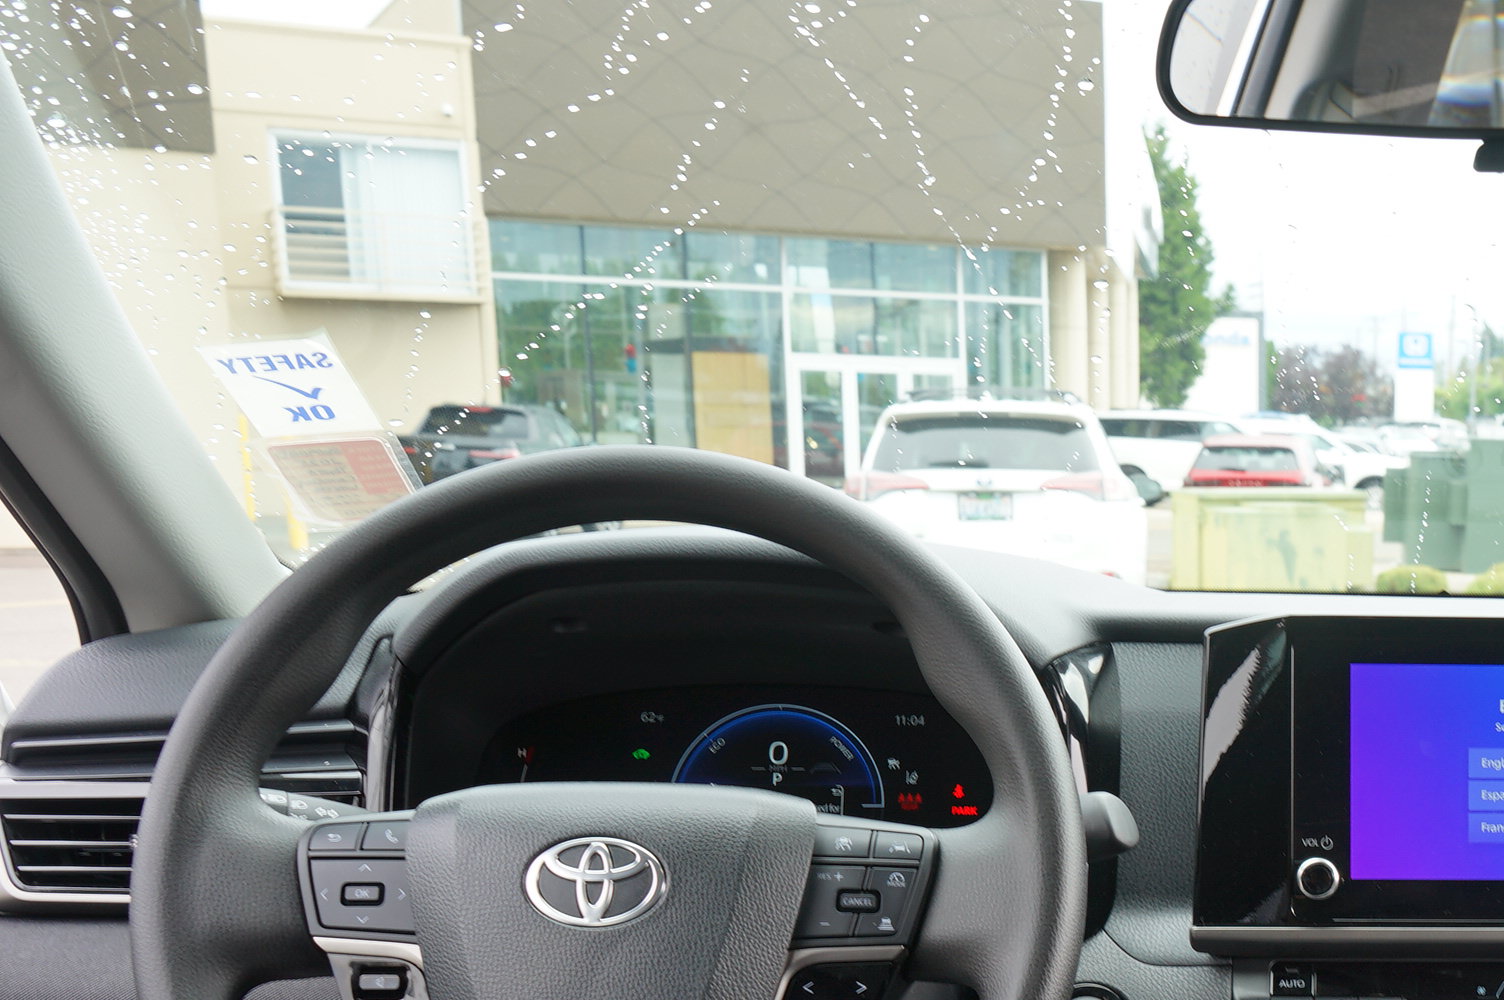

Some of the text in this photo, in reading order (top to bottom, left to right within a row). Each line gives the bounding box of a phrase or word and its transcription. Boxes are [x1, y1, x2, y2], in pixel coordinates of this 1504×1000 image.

[895, 714, 926, 727] 11:04
[708, 737, 726, 754] ECO
[829, 735, 855, 761] POWER
[772, 772, 783, 787] P
[951, 806, 978, 816] PARK
[1301, 837, 1319, 848] VOL
[354, 888, 370, 898] OK
[842, 899, 874, 908] CANCEL
[1279, 979, 1306, 989] AUTO
